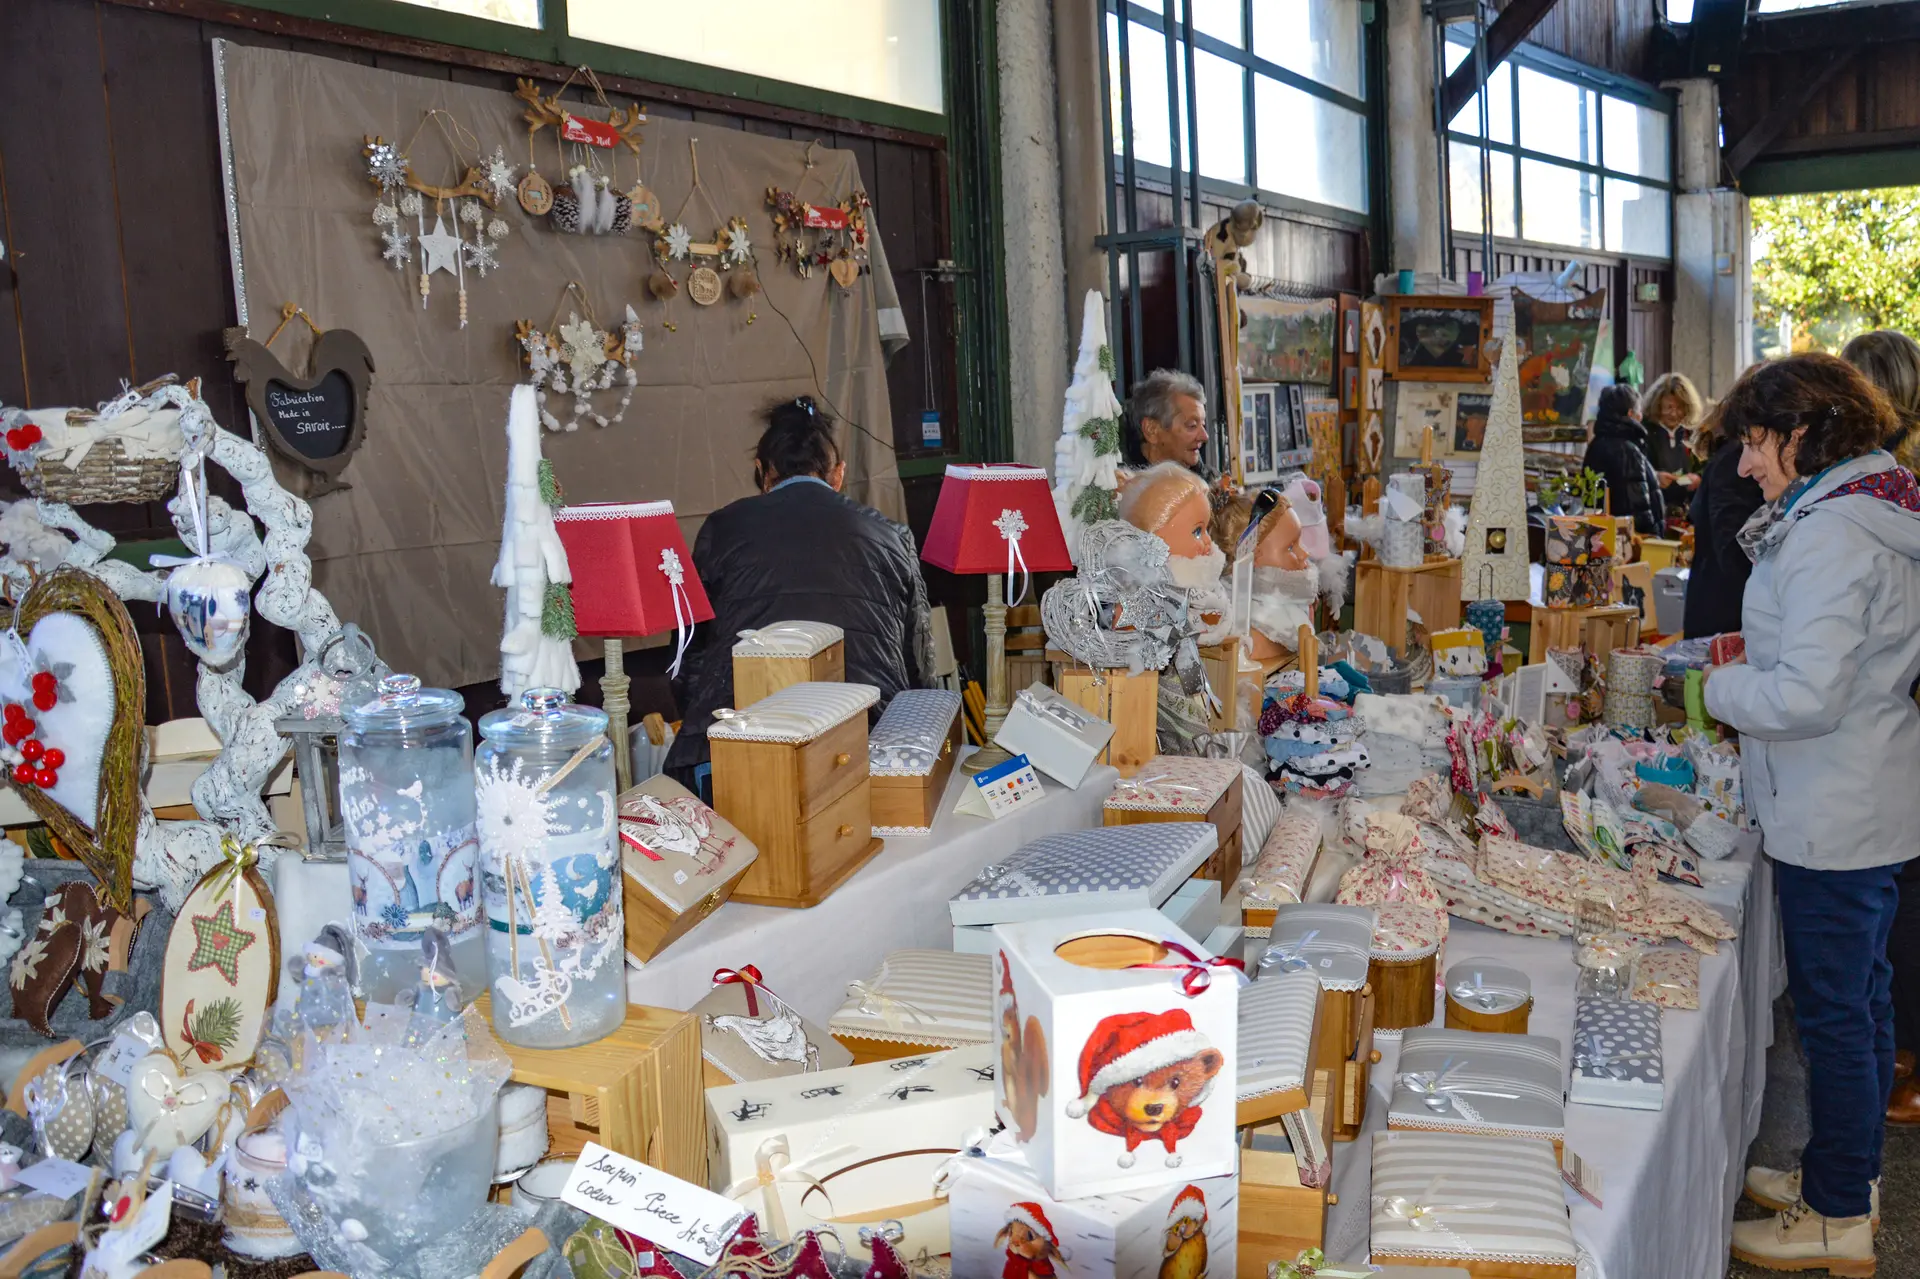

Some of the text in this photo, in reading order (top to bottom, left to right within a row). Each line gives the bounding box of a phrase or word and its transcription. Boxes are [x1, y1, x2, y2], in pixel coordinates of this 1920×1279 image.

[270, 392, 325, 407] Fabrication
[279, 408, 311, 419] Made in
